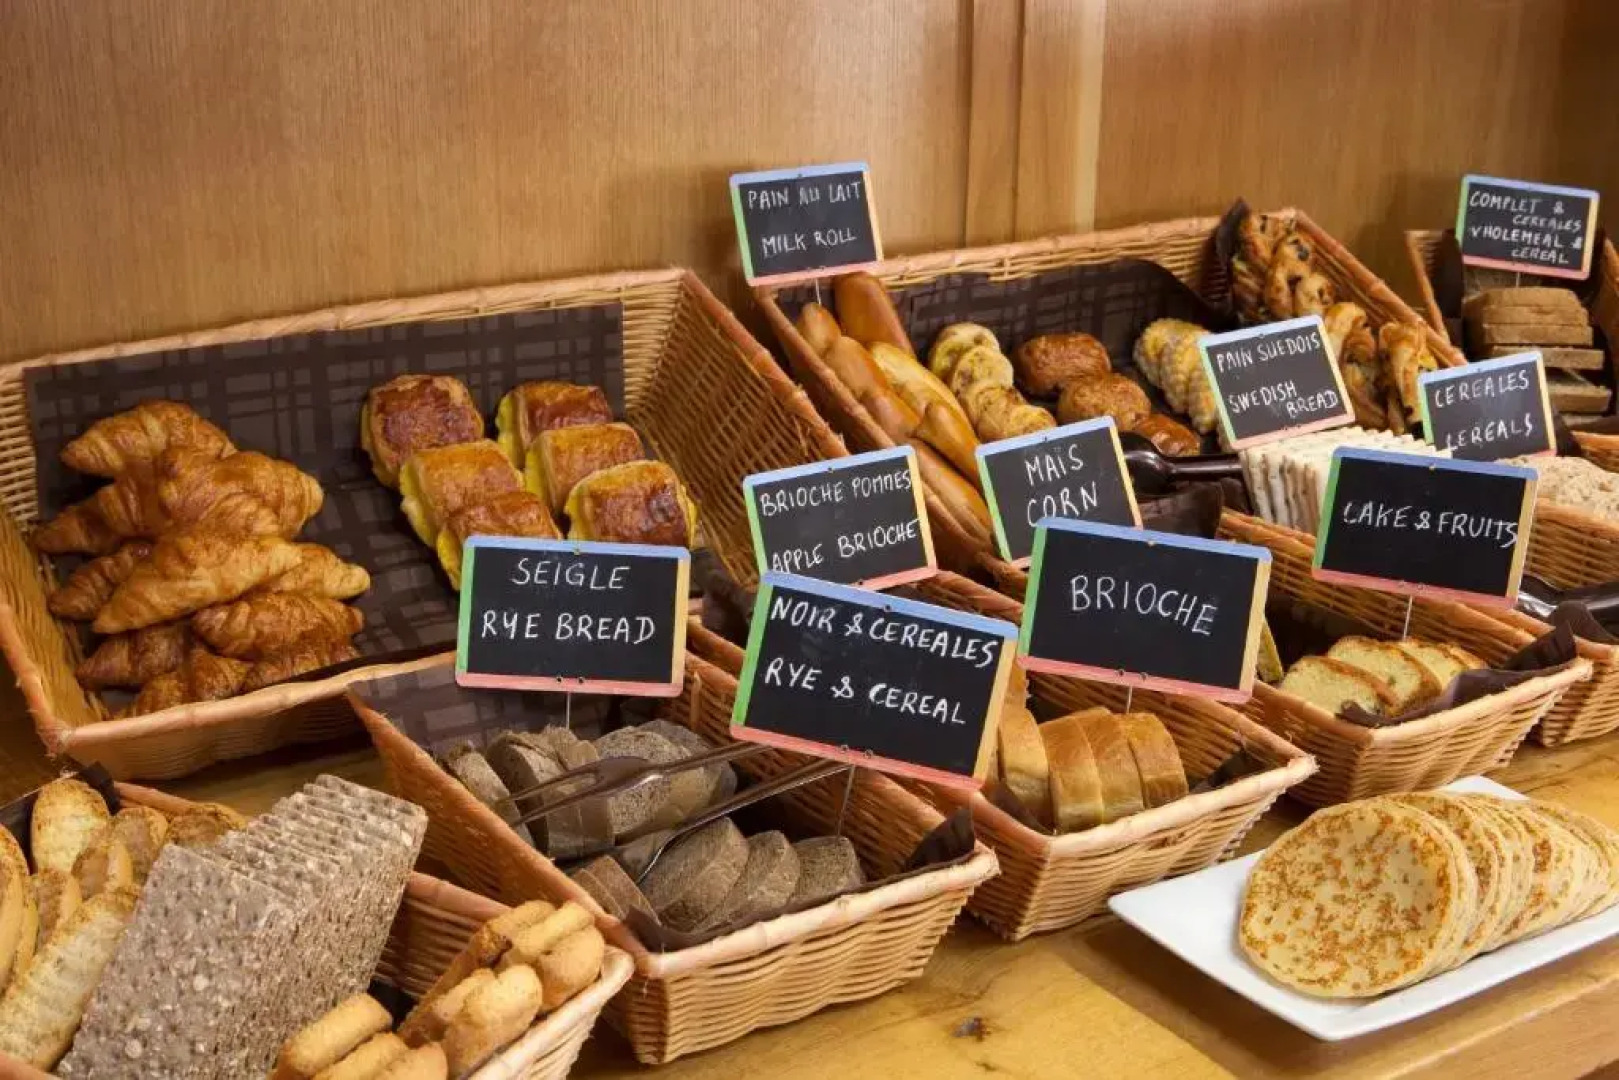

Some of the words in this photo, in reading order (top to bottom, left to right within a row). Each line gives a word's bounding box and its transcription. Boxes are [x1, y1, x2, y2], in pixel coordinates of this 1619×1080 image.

[748, 187, 789, 210] PAIN
[800, 187, 820, 205] AU
[829, 181, 861, 203] LAIT
[1470, 191, 1539, 214] COMPLET
[1553, 201, 1565, 215] &
[1513, 215, 1582, 232] CEREALES
[762, 233, 806, 259] MILK
[813, 228, 857, 246] ROLL
[1511, 249, 1569, 264] CEREAL
[1217, 348, 1252, 373] PAIN
[1257, 331, 1320, 361] SUEDOIS
[1229, 380, 1298, 414] SWEDISH
[1286, 389, 1338, 419] BREAD
[1435, 369, 1530, 408] CEREALES
[760, 481, 844, 517] BRIOCHE
[852, 470, 912, 498] POMMES
[1027, 480, 1098, 527] CORN
[772, 543, 824, 573] APPLE
[838, 518, 920, 558] BRIOCHE
[1414, 511, 1430, 530] &
[1438, 512, 1518, 547] FRUITS
[511, 557, 631, 590] SEIGLE
[1070, 574, 1218, 636] BRIOCHE
[481, 609, 541, 640] RYE
[555, 612, 656, 645] BREAD
[770, 597, 836, 634] NOIR
[844, 612, 862, 637] &
[868, 617, 999, 668] CEREALES
[764, 657, 822, 690] RYE
[830, 676, 854, 699] &
[868, 682, 966, 725] CEREAL
